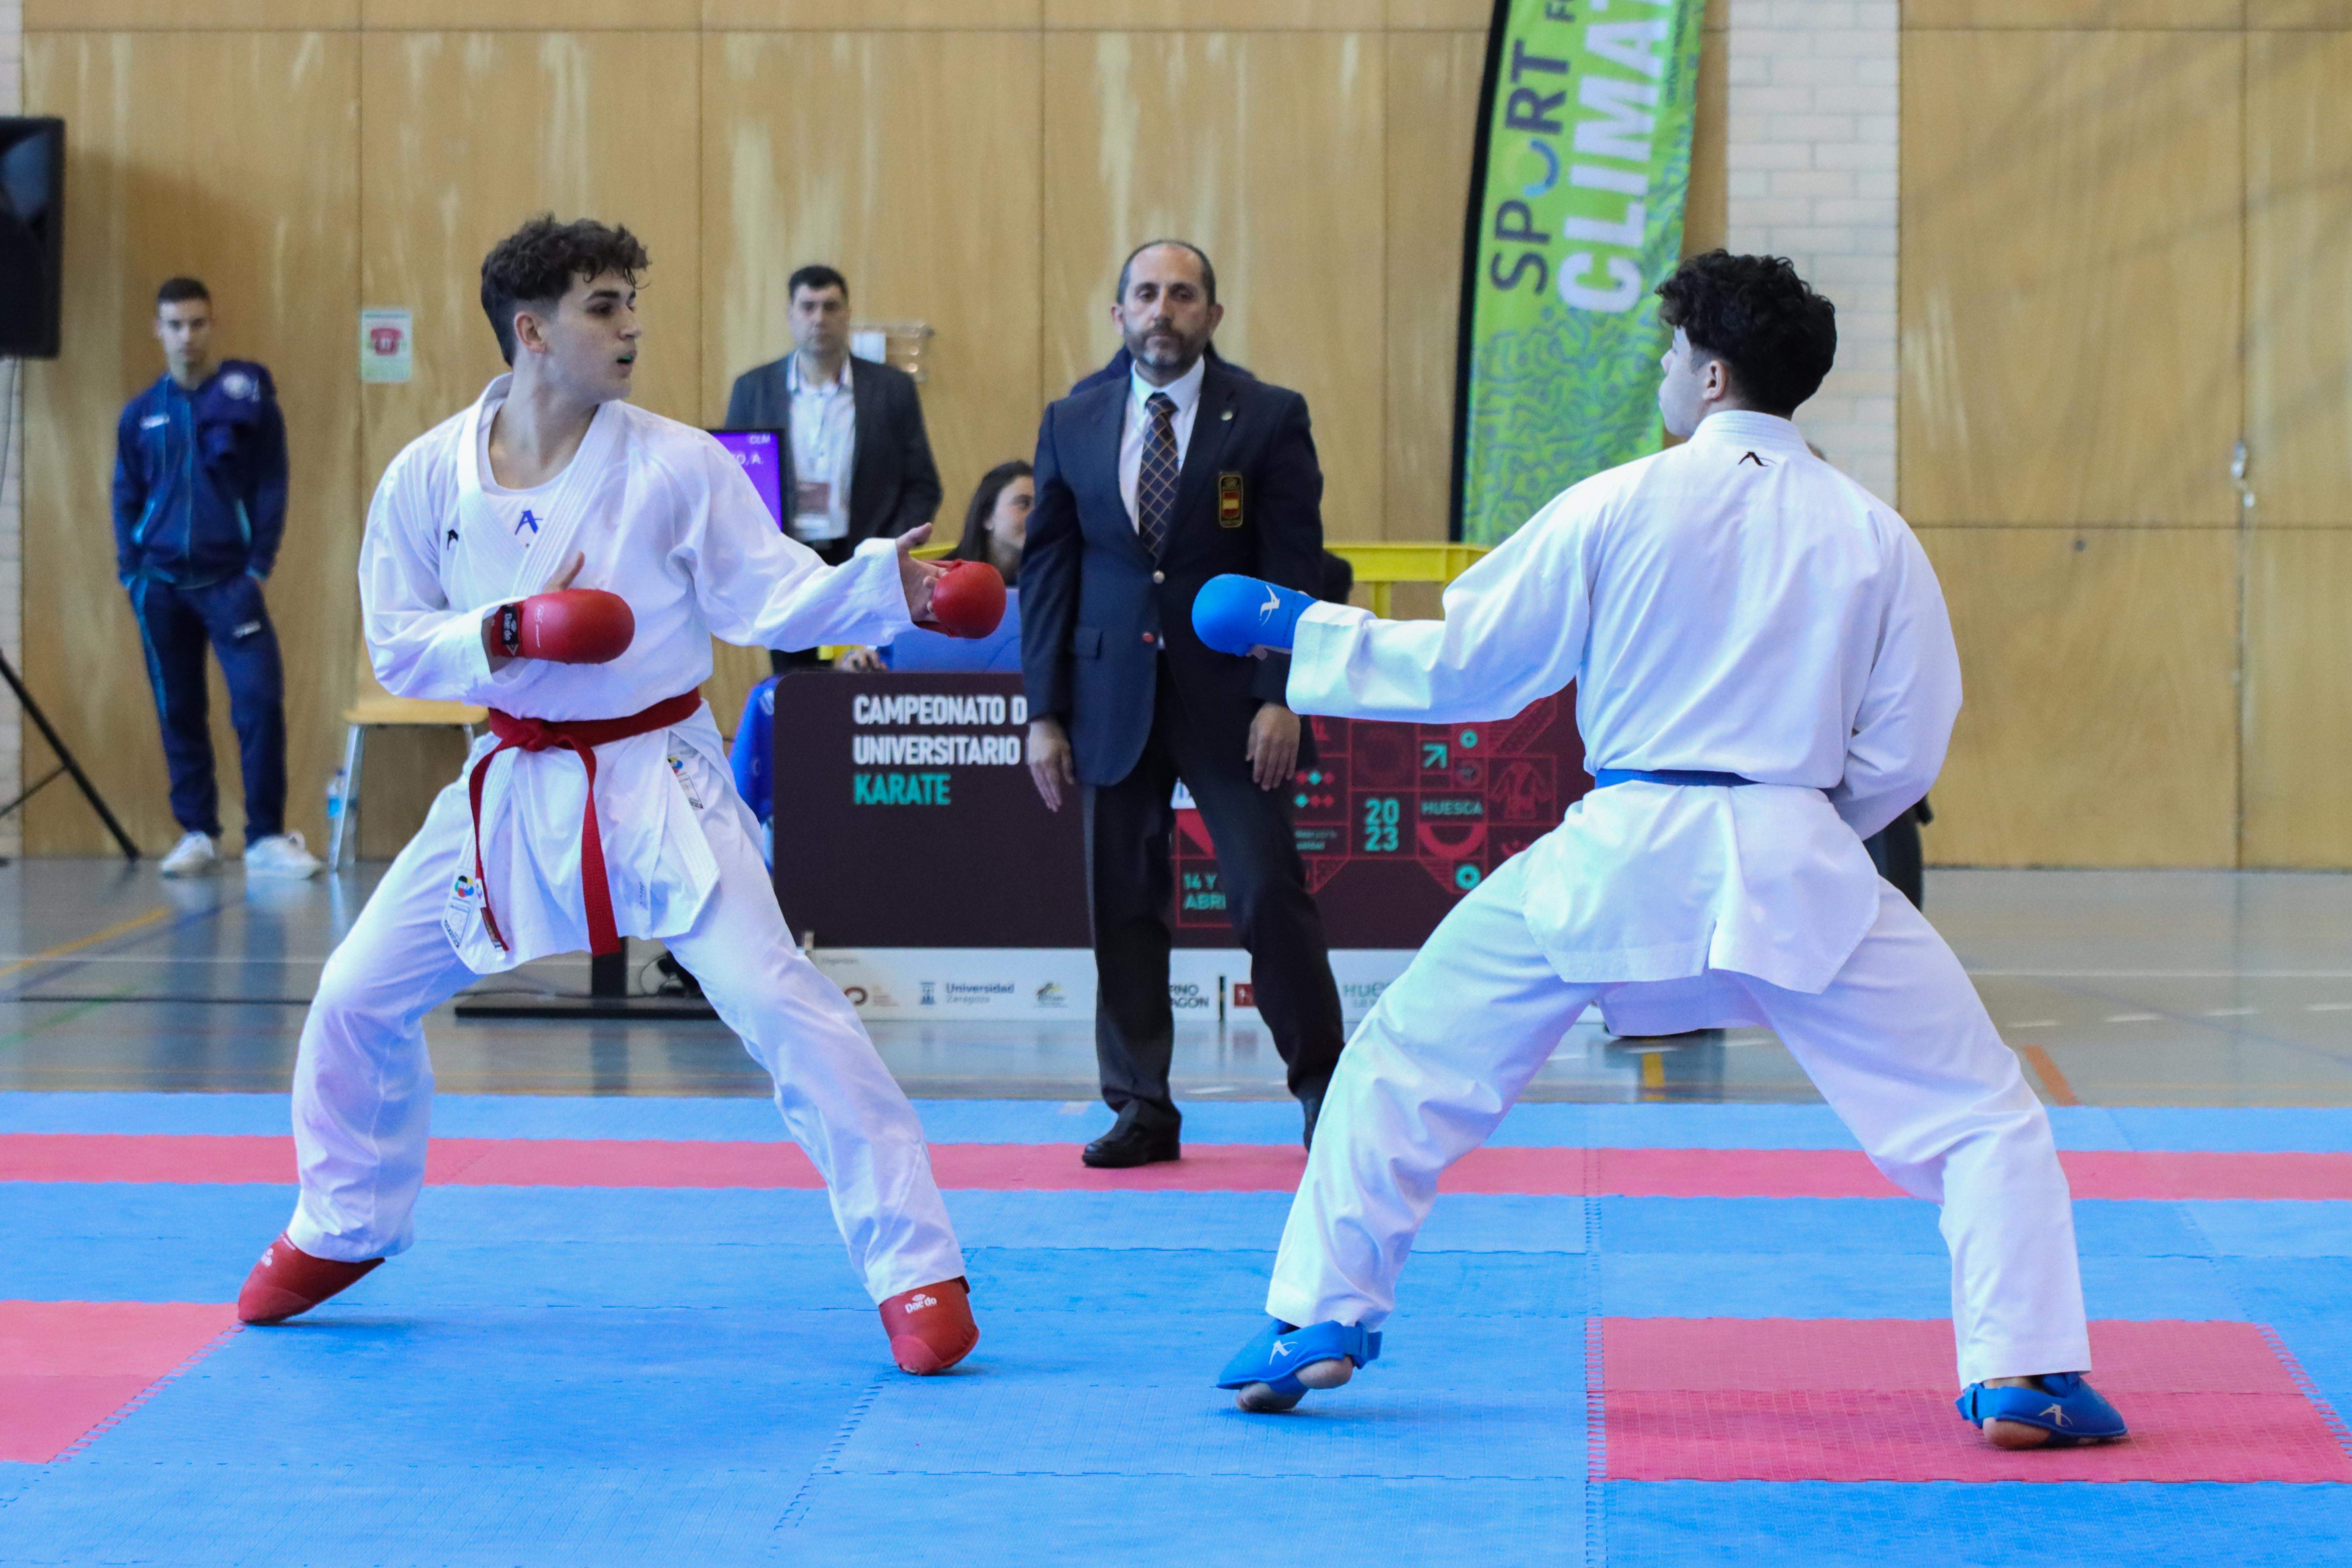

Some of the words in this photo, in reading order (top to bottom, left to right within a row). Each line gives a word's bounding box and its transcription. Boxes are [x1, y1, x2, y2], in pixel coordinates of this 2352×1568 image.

[854, 695, 1006, 725] CAMPEONATO
[853, 735, 1021, 766] UNIVERSITARIO
[853, 773, 951, 805] KARATE
[1365, 798, 1400, 825] 20
[1421, 801, 1483, 815] HUESCA
[1365, 825, 1399, 851] 23
[946, 983, 1014, 994] Universidad
